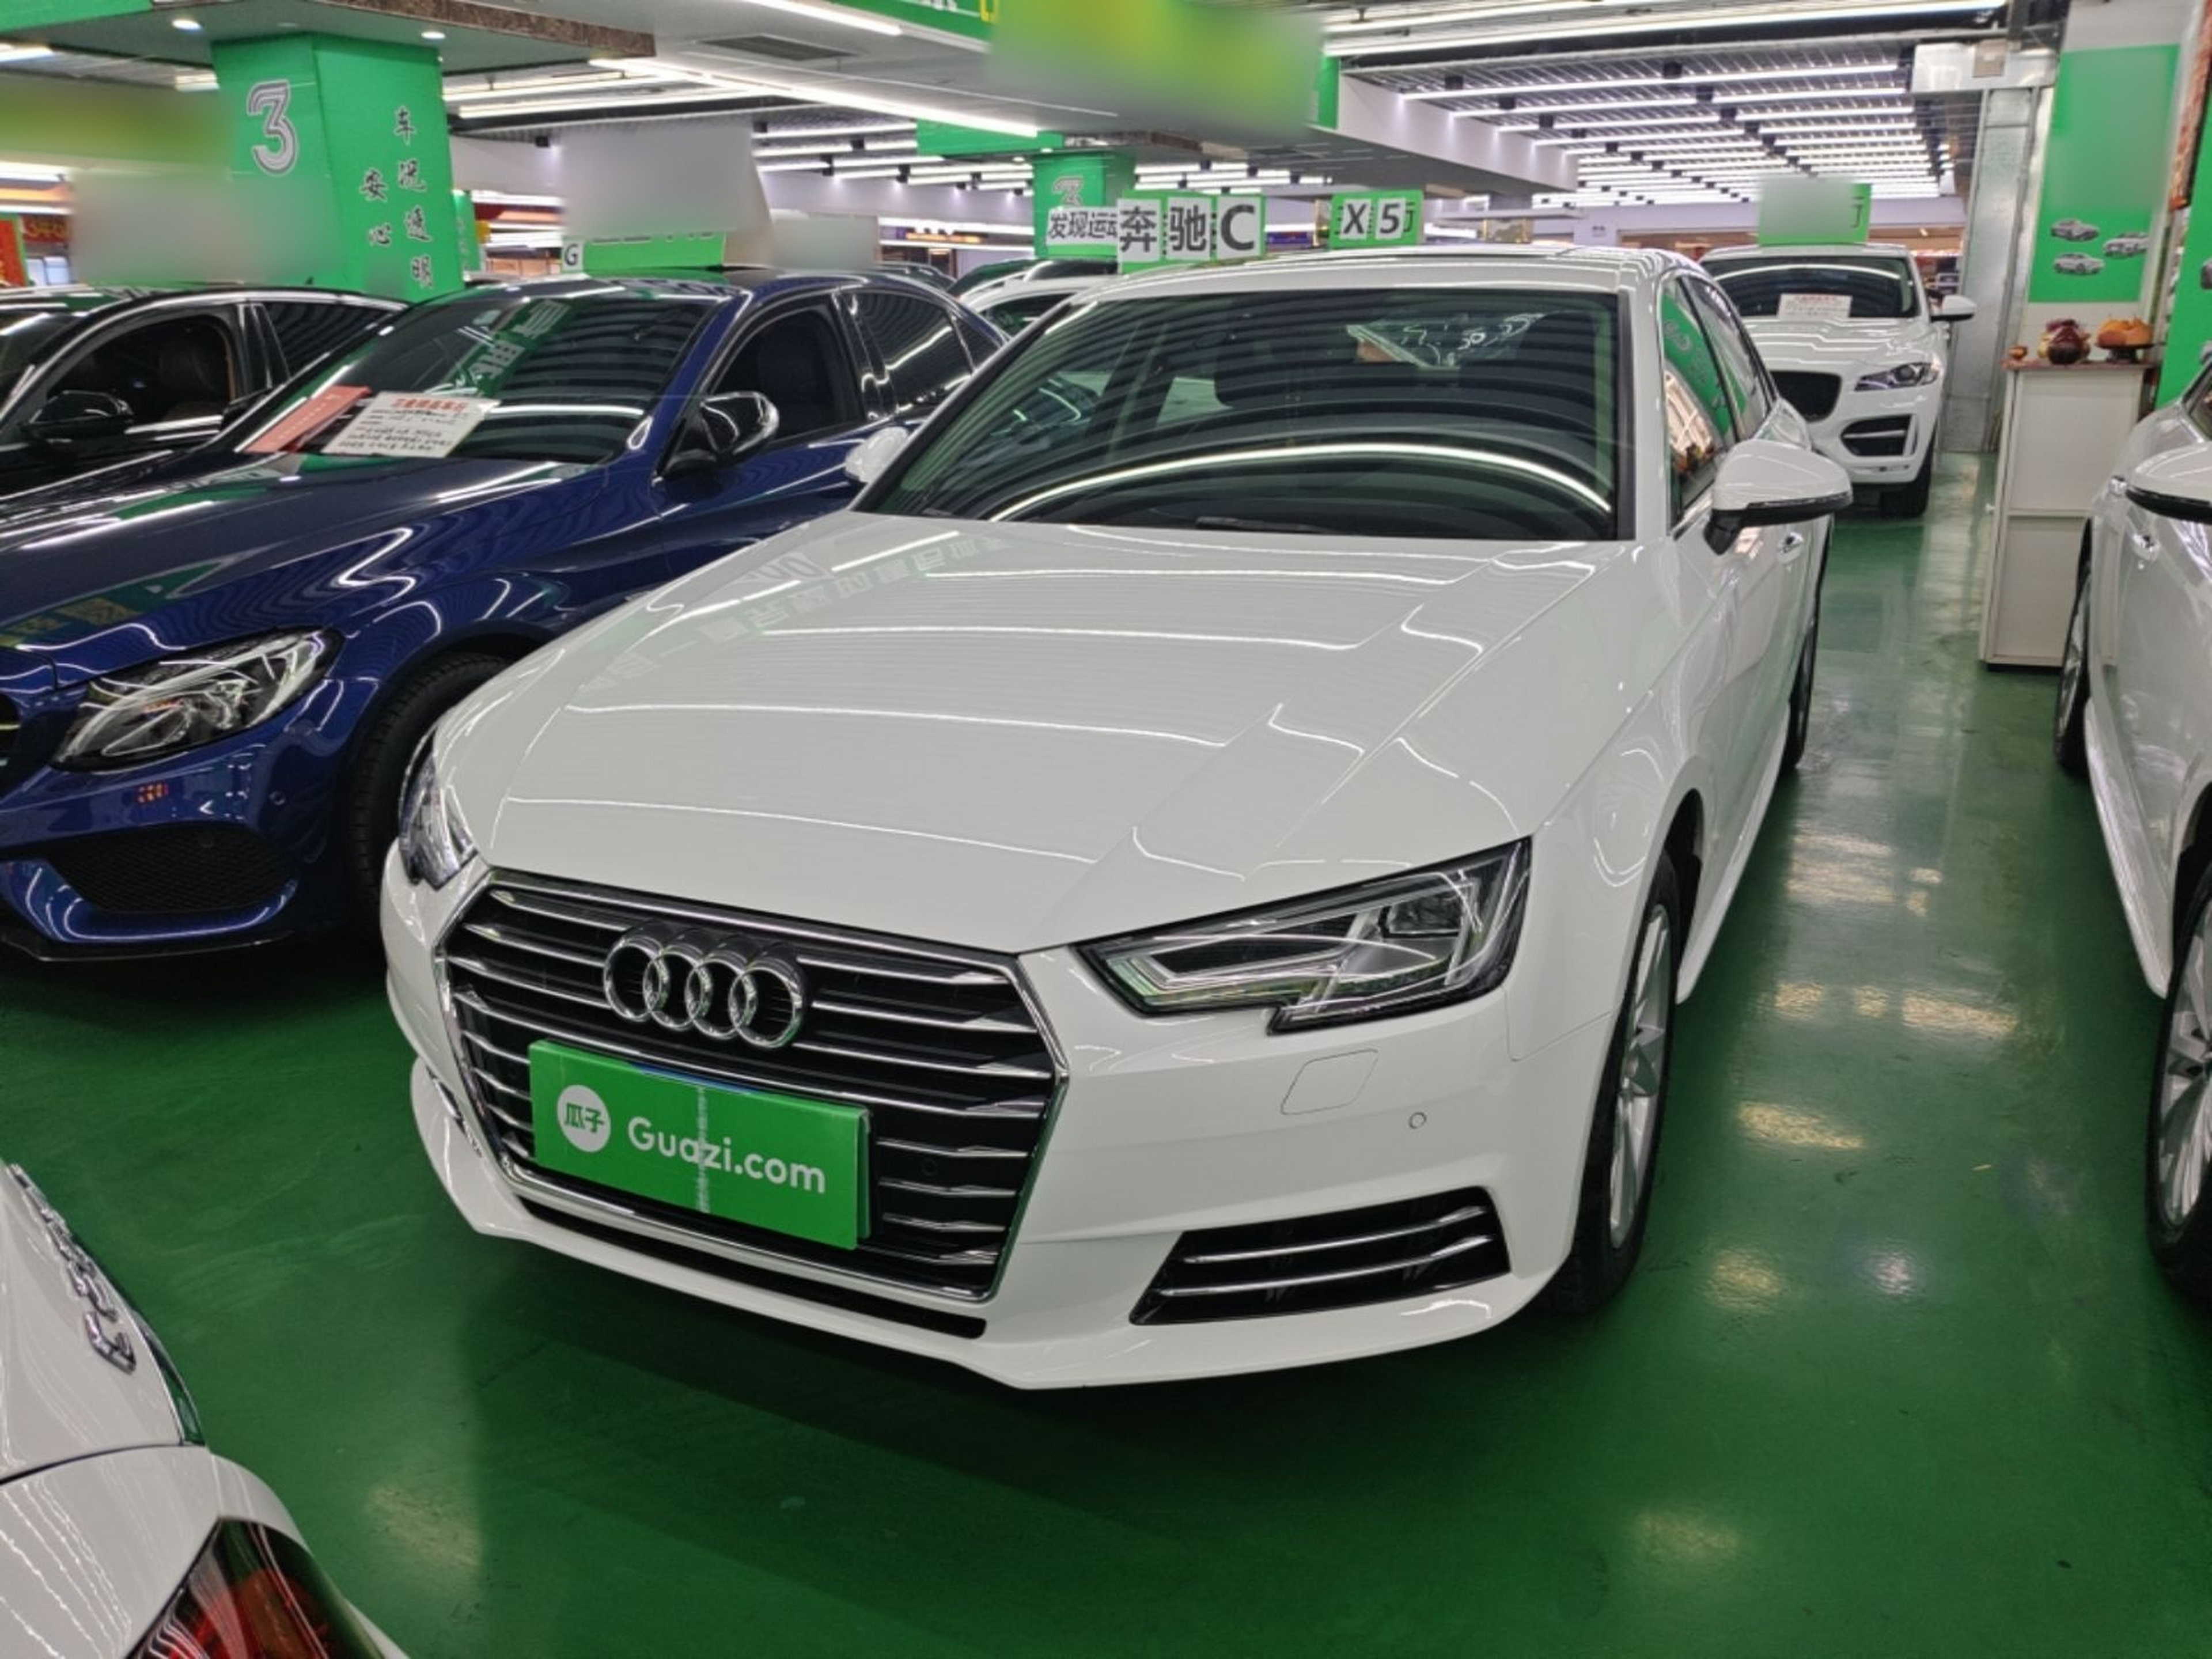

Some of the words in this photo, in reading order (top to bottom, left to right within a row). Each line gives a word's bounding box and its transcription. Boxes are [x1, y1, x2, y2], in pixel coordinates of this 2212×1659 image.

[247, 78, 298, 177] 3
[565, 1102, 604, 1133] 瓜子
[628, 1116, 825, 1194] Guazi.com
